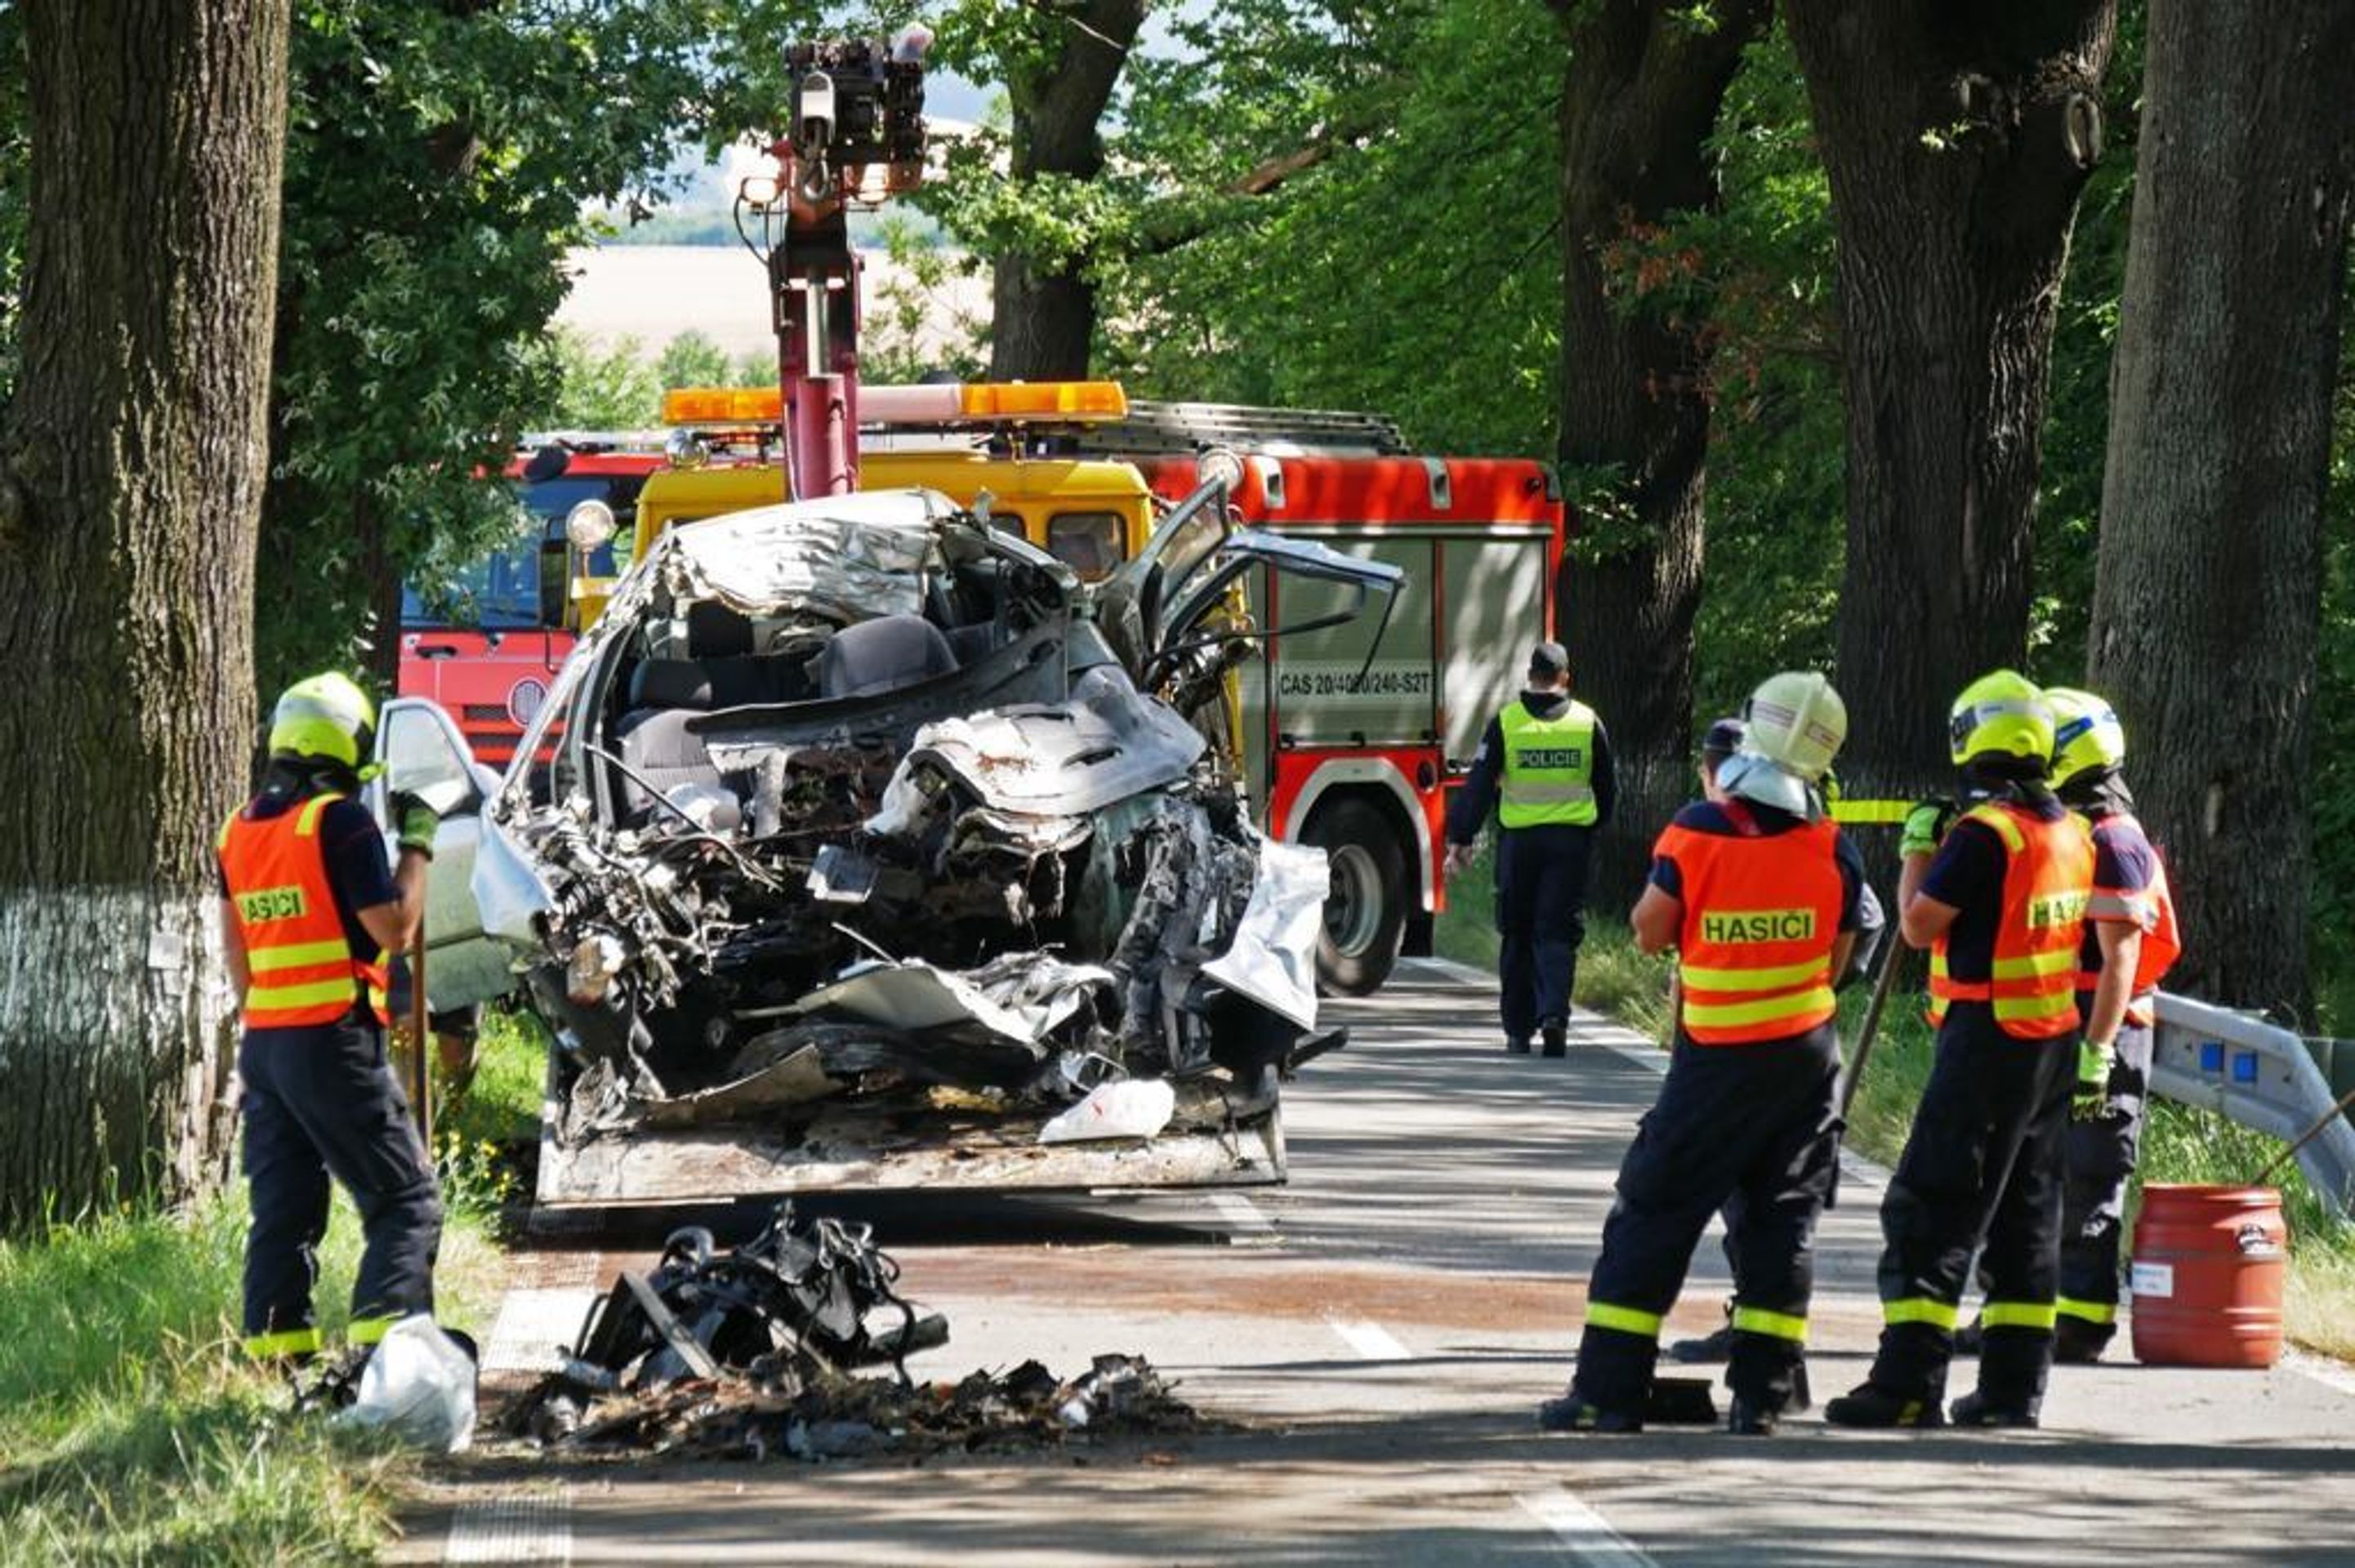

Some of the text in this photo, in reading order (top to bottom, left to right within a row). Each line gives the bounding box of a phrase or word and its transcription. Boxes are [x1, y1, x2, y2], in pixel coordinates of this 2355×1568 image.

[1281, 674, 1312, 694] CAS
[1519, 751, 1579, 767] POLICIE
[1706, 911, 1812, 942] HASIČI
